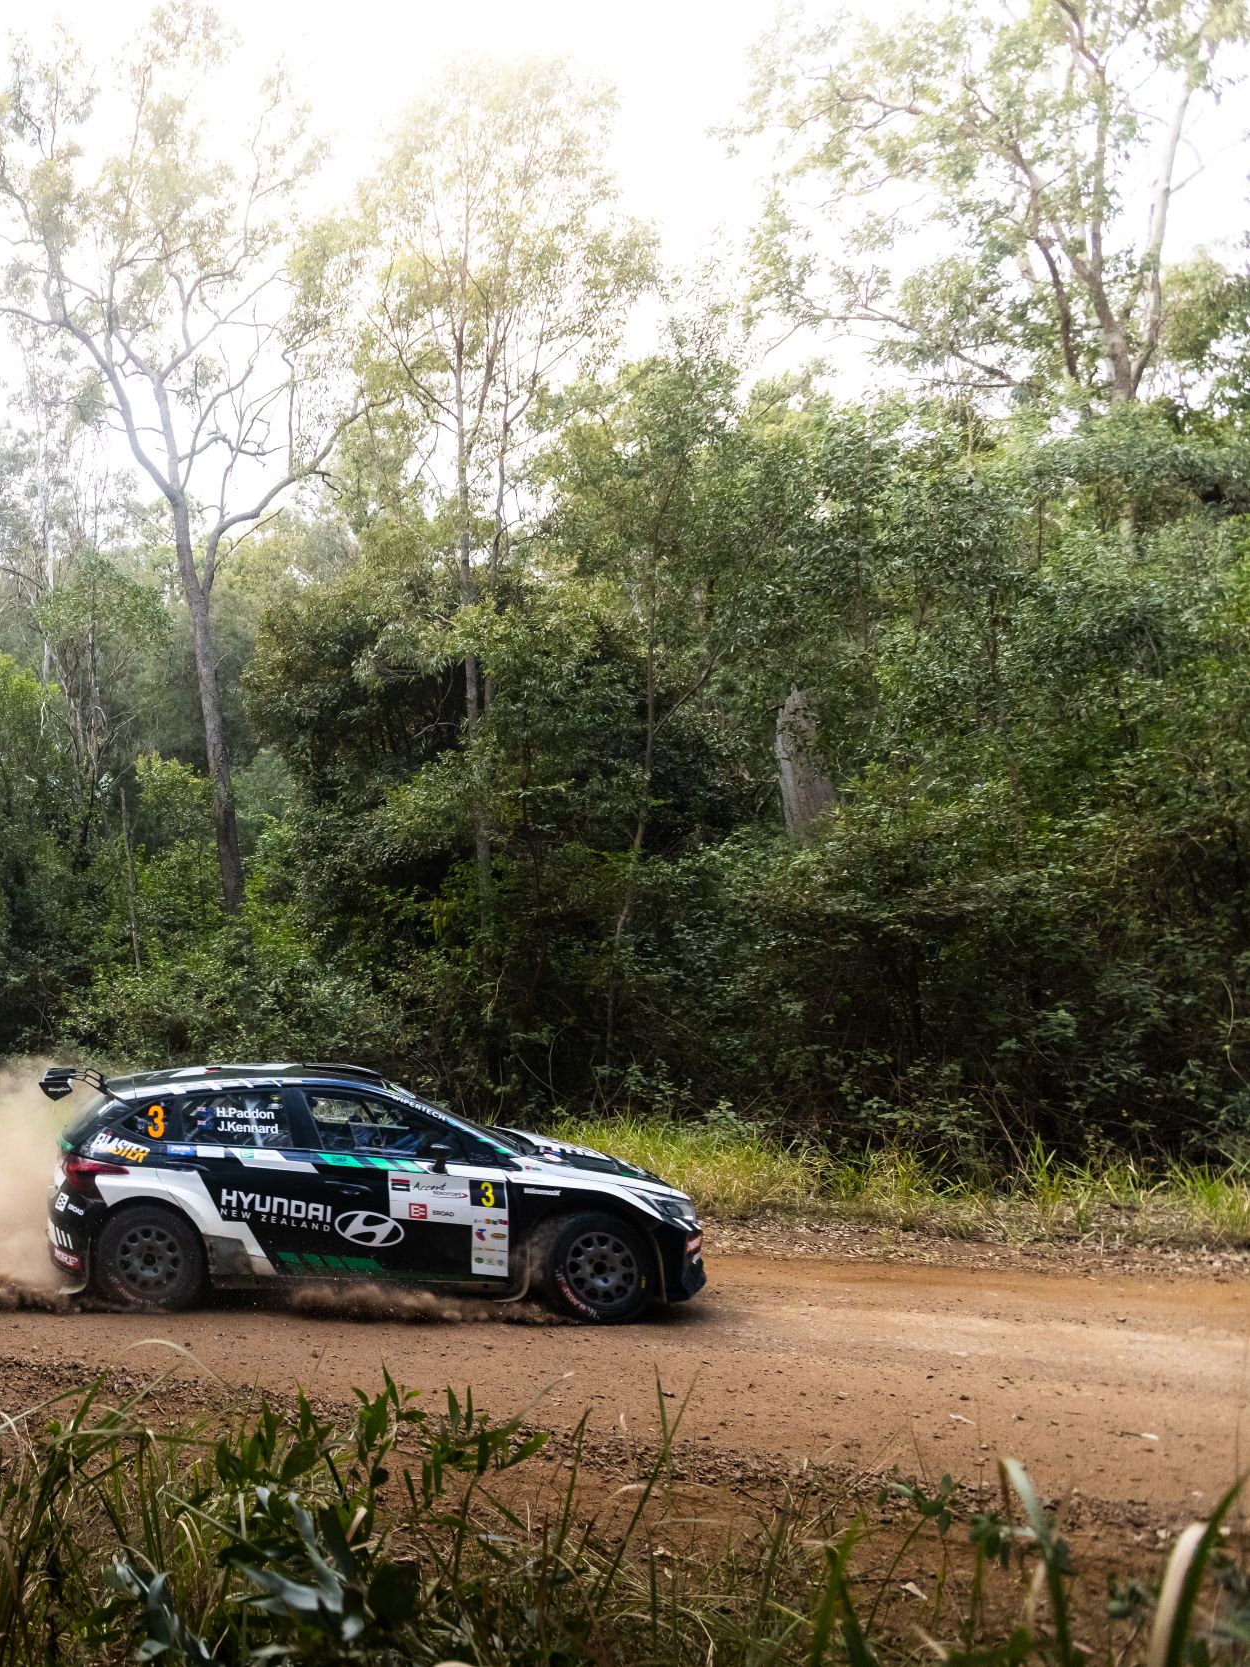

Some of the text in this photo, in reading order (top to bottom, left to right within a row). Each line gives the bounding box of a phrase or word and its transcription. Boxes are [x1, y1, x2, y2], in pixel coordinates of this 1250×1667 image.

[148, 1105, 165, 1139] 3
[215, 1106, 275, 1120] H.Paddon
[391, 1095, 447, 1122] WIPERTECH
[217, 1120, 279, 1135] J.Kennard
[90, 1132, 151, 1163] BLASTER
[413, 1181, 447, 1191] Accent
[480, 1181, 495, 1208] 3
[221, 1188, 332, 1223] HYUNDAI
[220, 1207, 331, 1232] NEW ZEALAND
